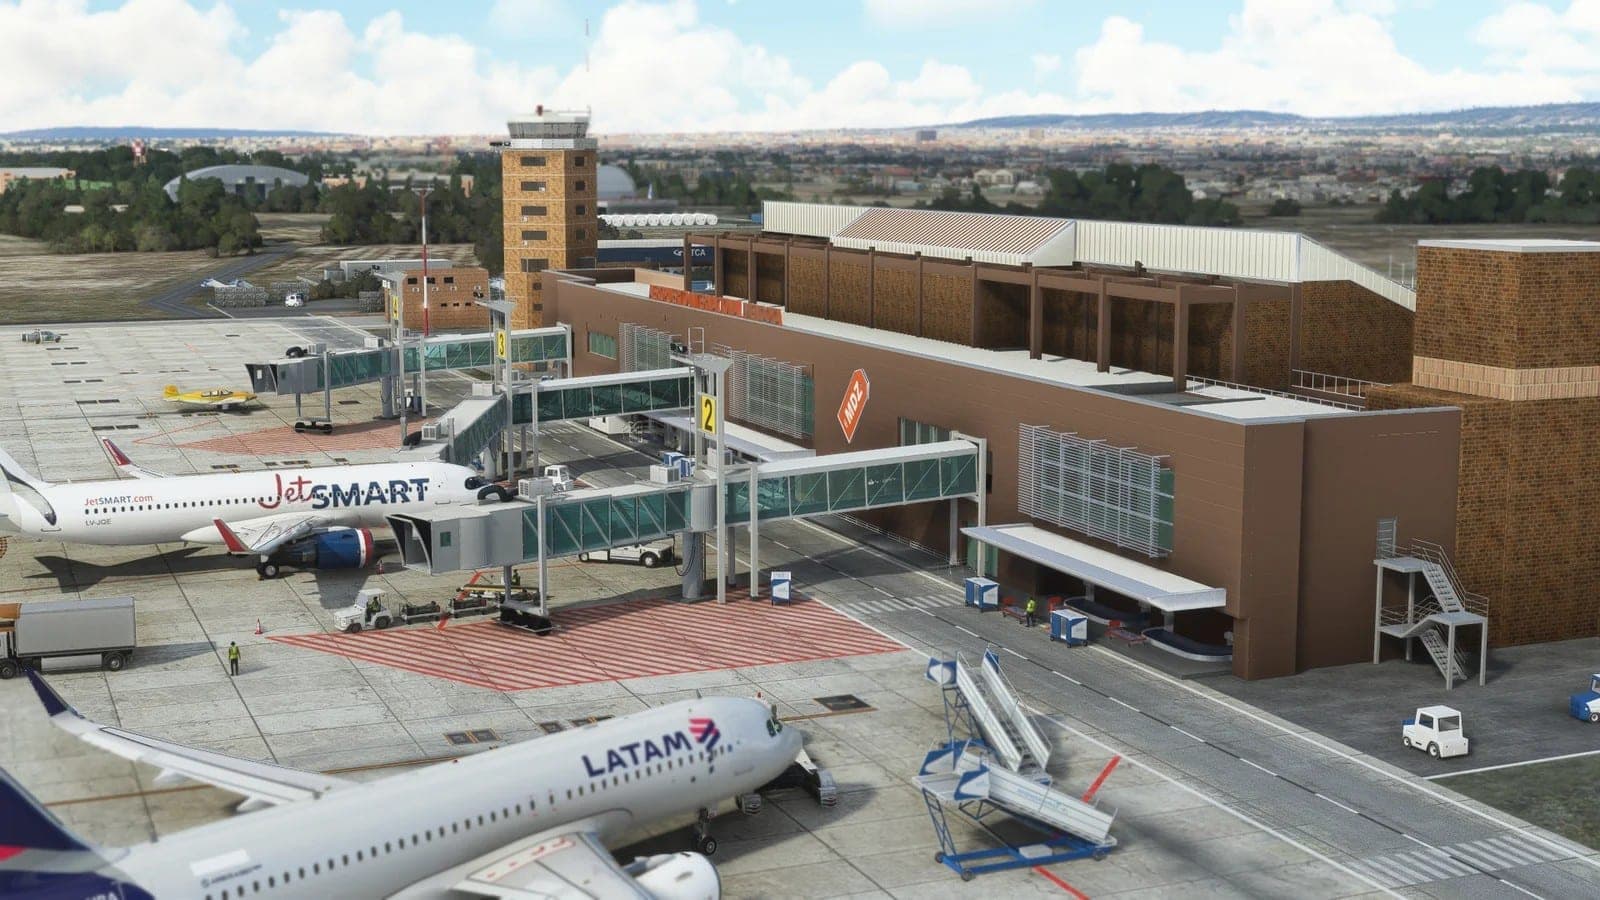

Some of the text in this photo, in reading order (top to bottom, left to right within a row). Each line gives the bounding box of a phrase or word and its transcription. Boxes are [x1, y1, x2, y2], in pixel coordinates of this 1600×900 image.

[704, 398, 713, 432] 2
[844, 380, 863, 424] MDZ
[84, 495, 153, 506] JetSMART.com
[581, 731, 692, 777] LATAM
